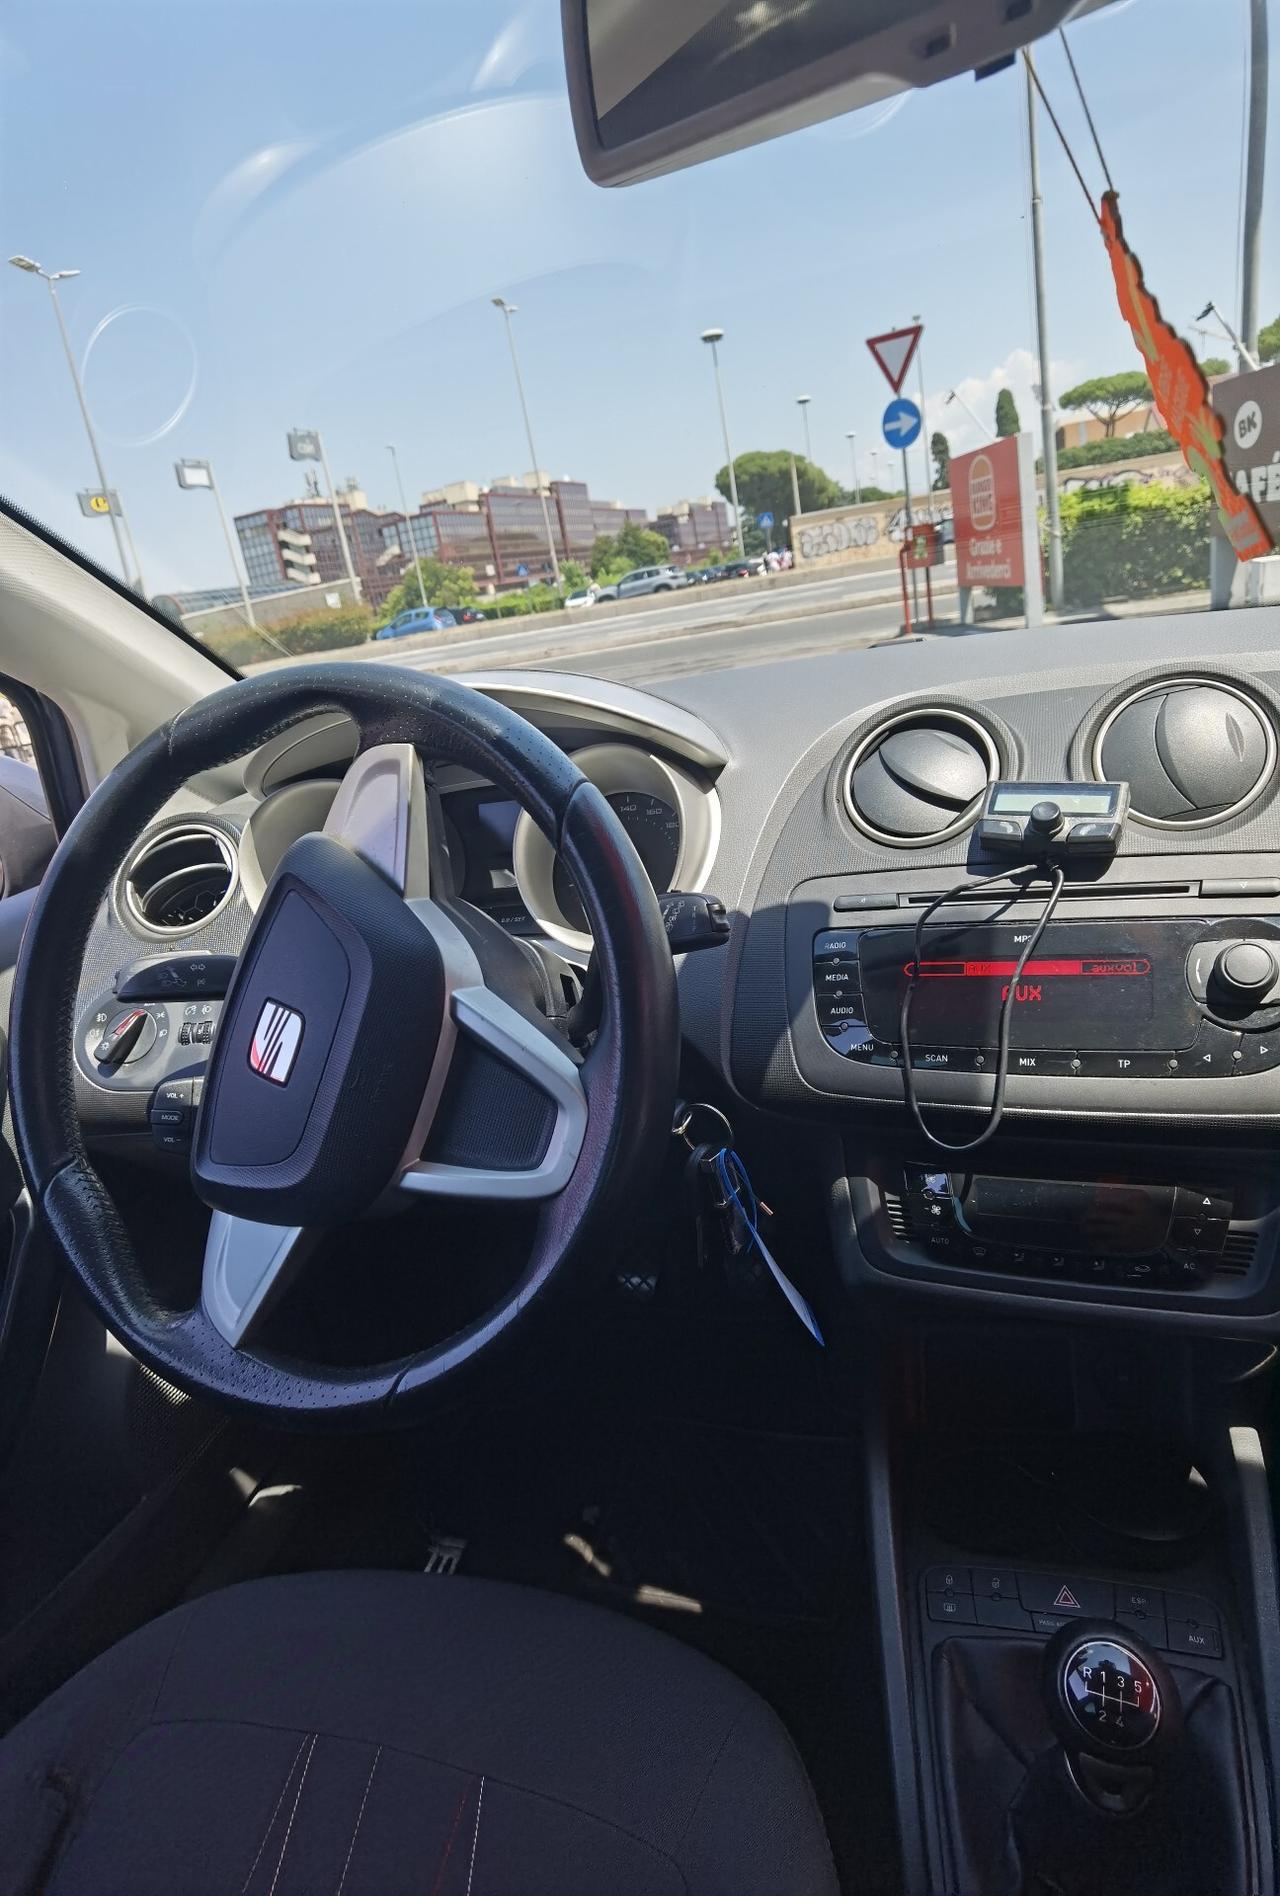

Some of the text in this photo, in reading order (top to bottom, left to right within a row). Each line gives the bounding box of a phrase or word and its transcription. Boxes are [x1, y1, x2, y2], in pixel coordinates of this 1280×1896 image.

[1239, 411, 1257, 438] BK
[1230, 450, 1280, 503] AFÉ
[825, 974, 849, 982] MEDIA
[830, 1006, 854, 1014] AUDIO
[925, 1054, 948, 1062] SCAN
[1019, 1058, 1036, 1066] MIX
[1118, 1060, 1130, 1068] TP
[931, 1237, 950, 1245] AUTO
[1188, 1635, 1206, 1646] AUX
[1083, 1667, 1092, 1679] R
[1117, 1676, 1125, 1688] 3
[1134, 1681, 1142, 1693] 5
[1099, 1710, 1124, 1729] 2 4
